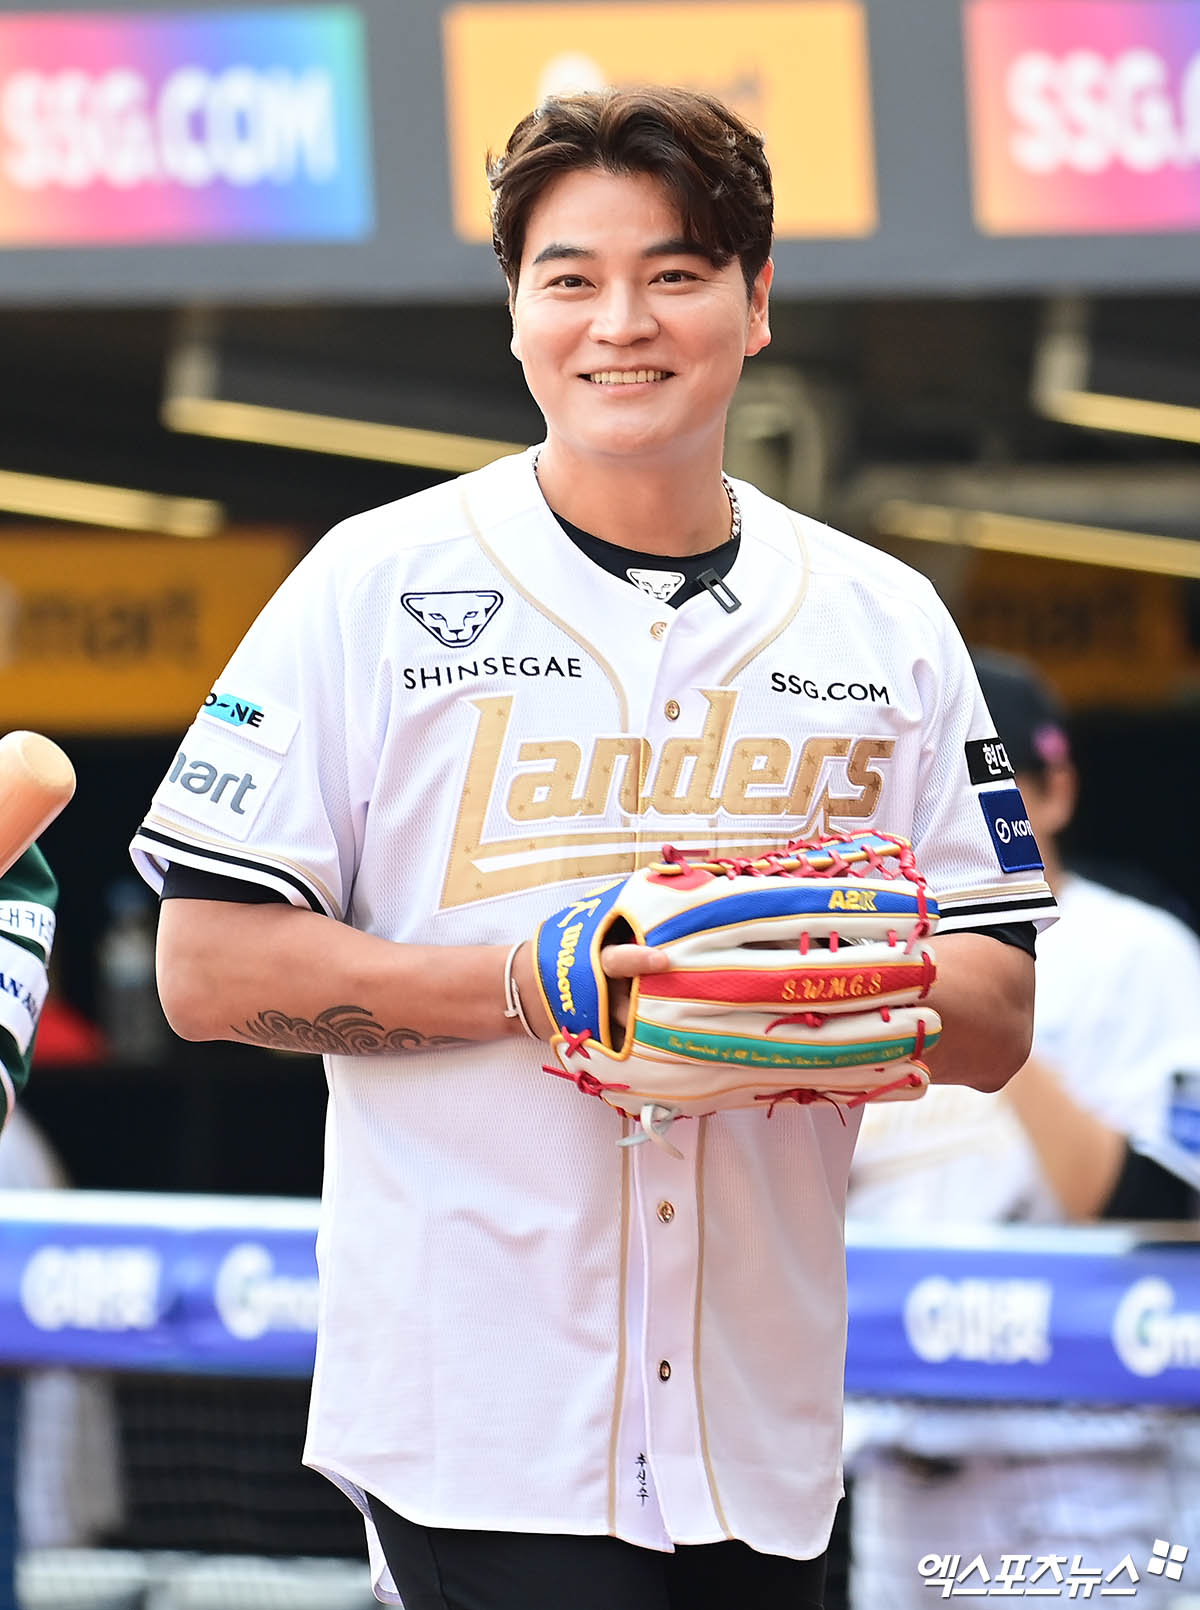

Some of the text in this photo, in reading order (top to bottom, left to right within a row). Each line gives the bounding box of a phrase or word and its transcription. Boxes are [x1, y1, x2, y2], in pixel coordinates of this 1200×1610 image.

[403, 655, 582, 690] SHINSEGAE
[771, 672, 890, 705] SSG.COM
[434, 686, 900, 916] Landers
[827, 889, 879, 913] A2K
[555, 921, 585, 1017] Wilson
